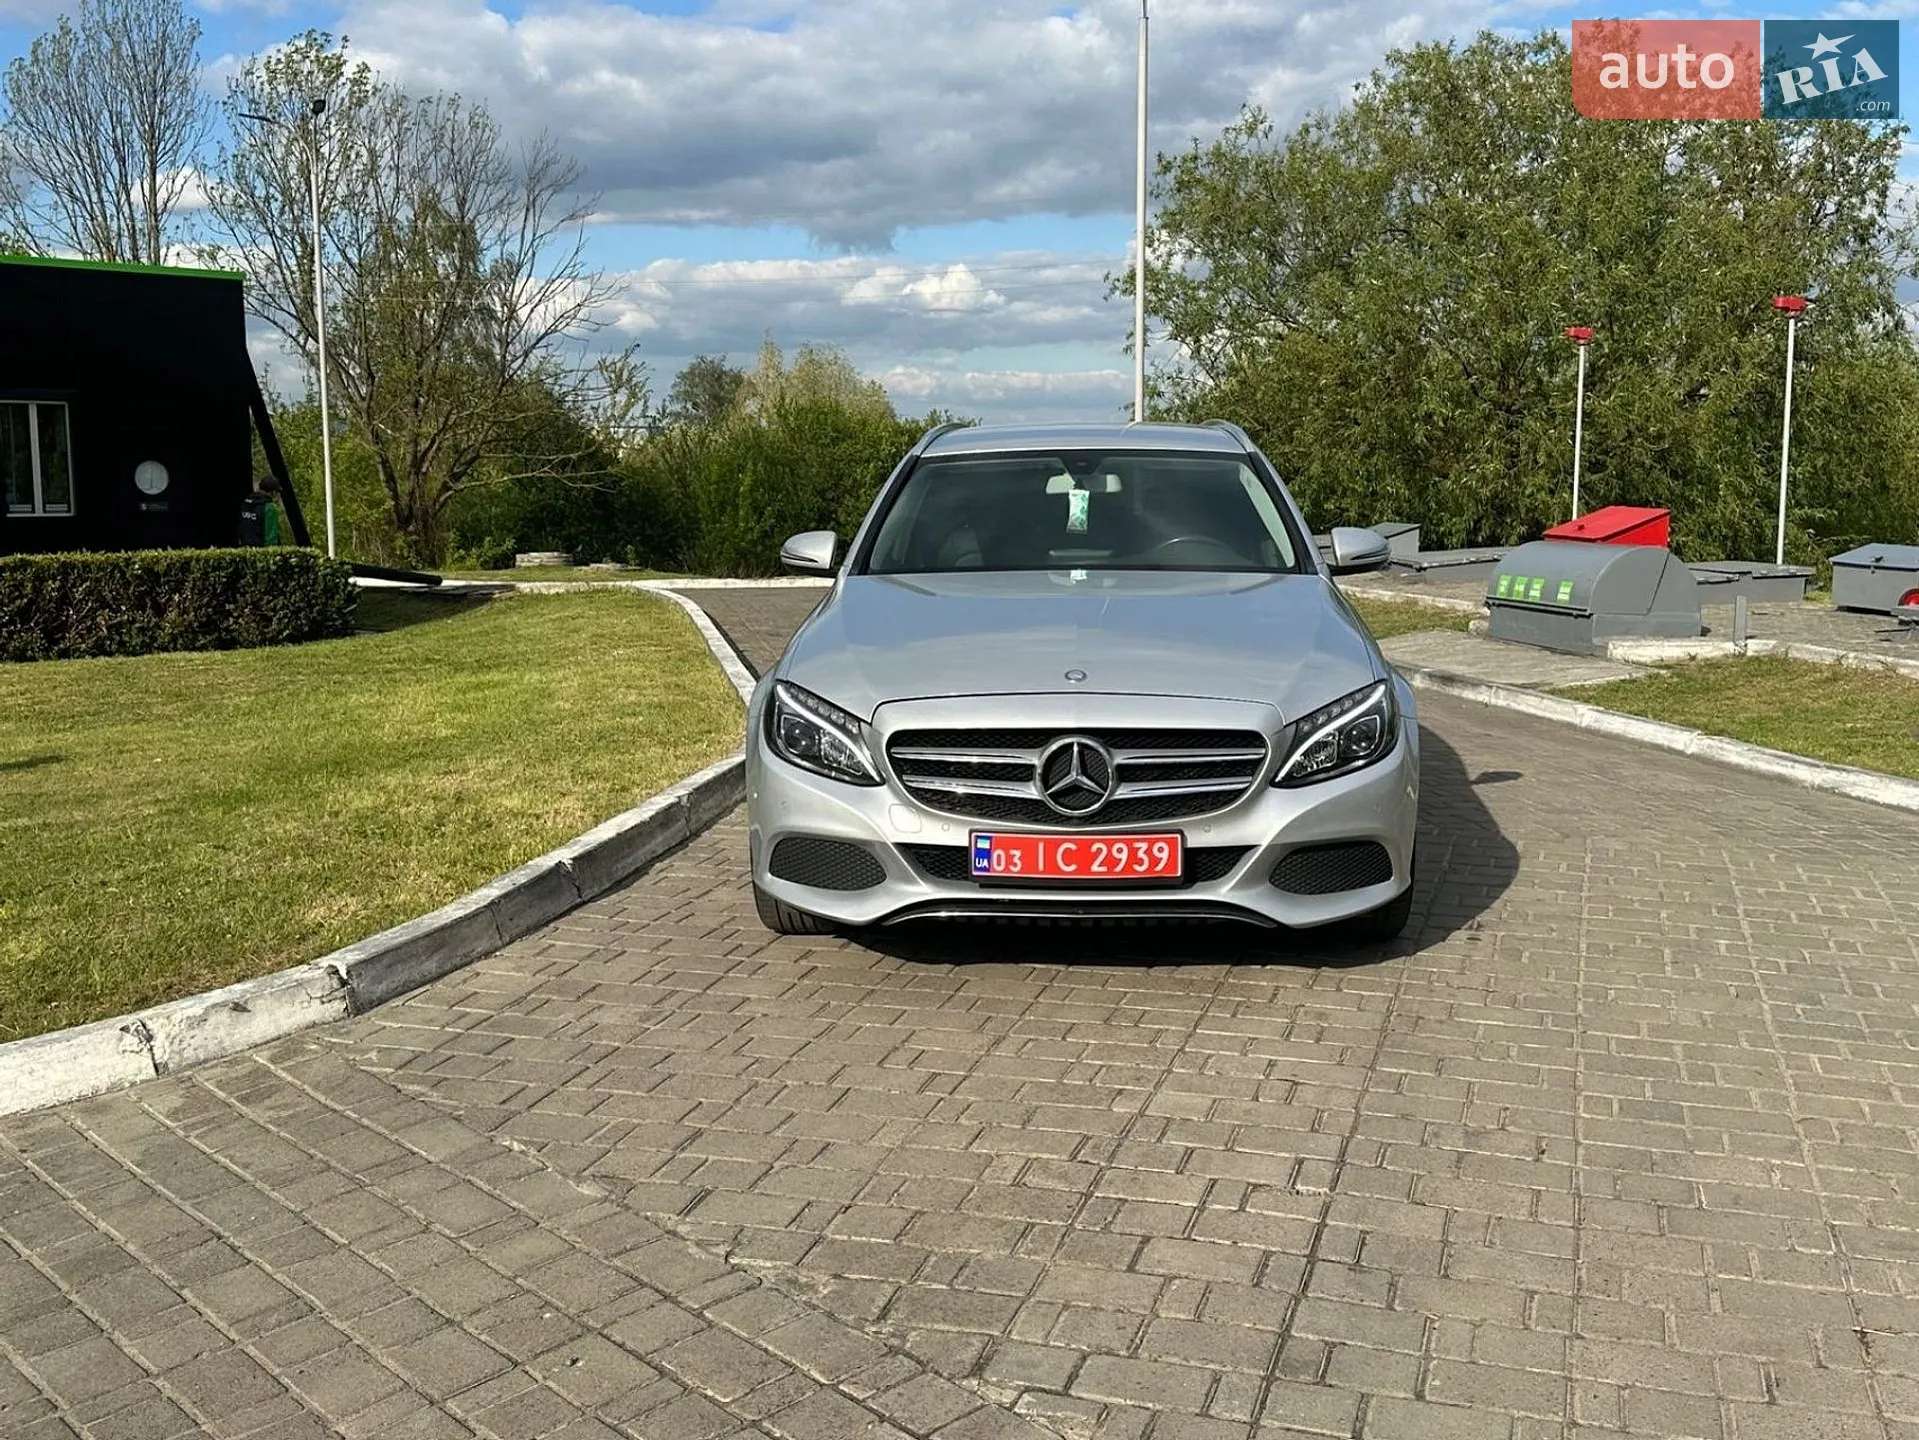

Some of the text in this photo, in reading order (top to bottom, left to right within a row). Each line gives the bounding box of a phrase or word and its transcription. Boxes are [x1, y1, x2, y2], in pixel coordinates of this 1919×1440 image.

[975, 858, 989, 868] UA
[992, 849, 1022, 872] 03
[1090, 841, 1170, 872] 2939
